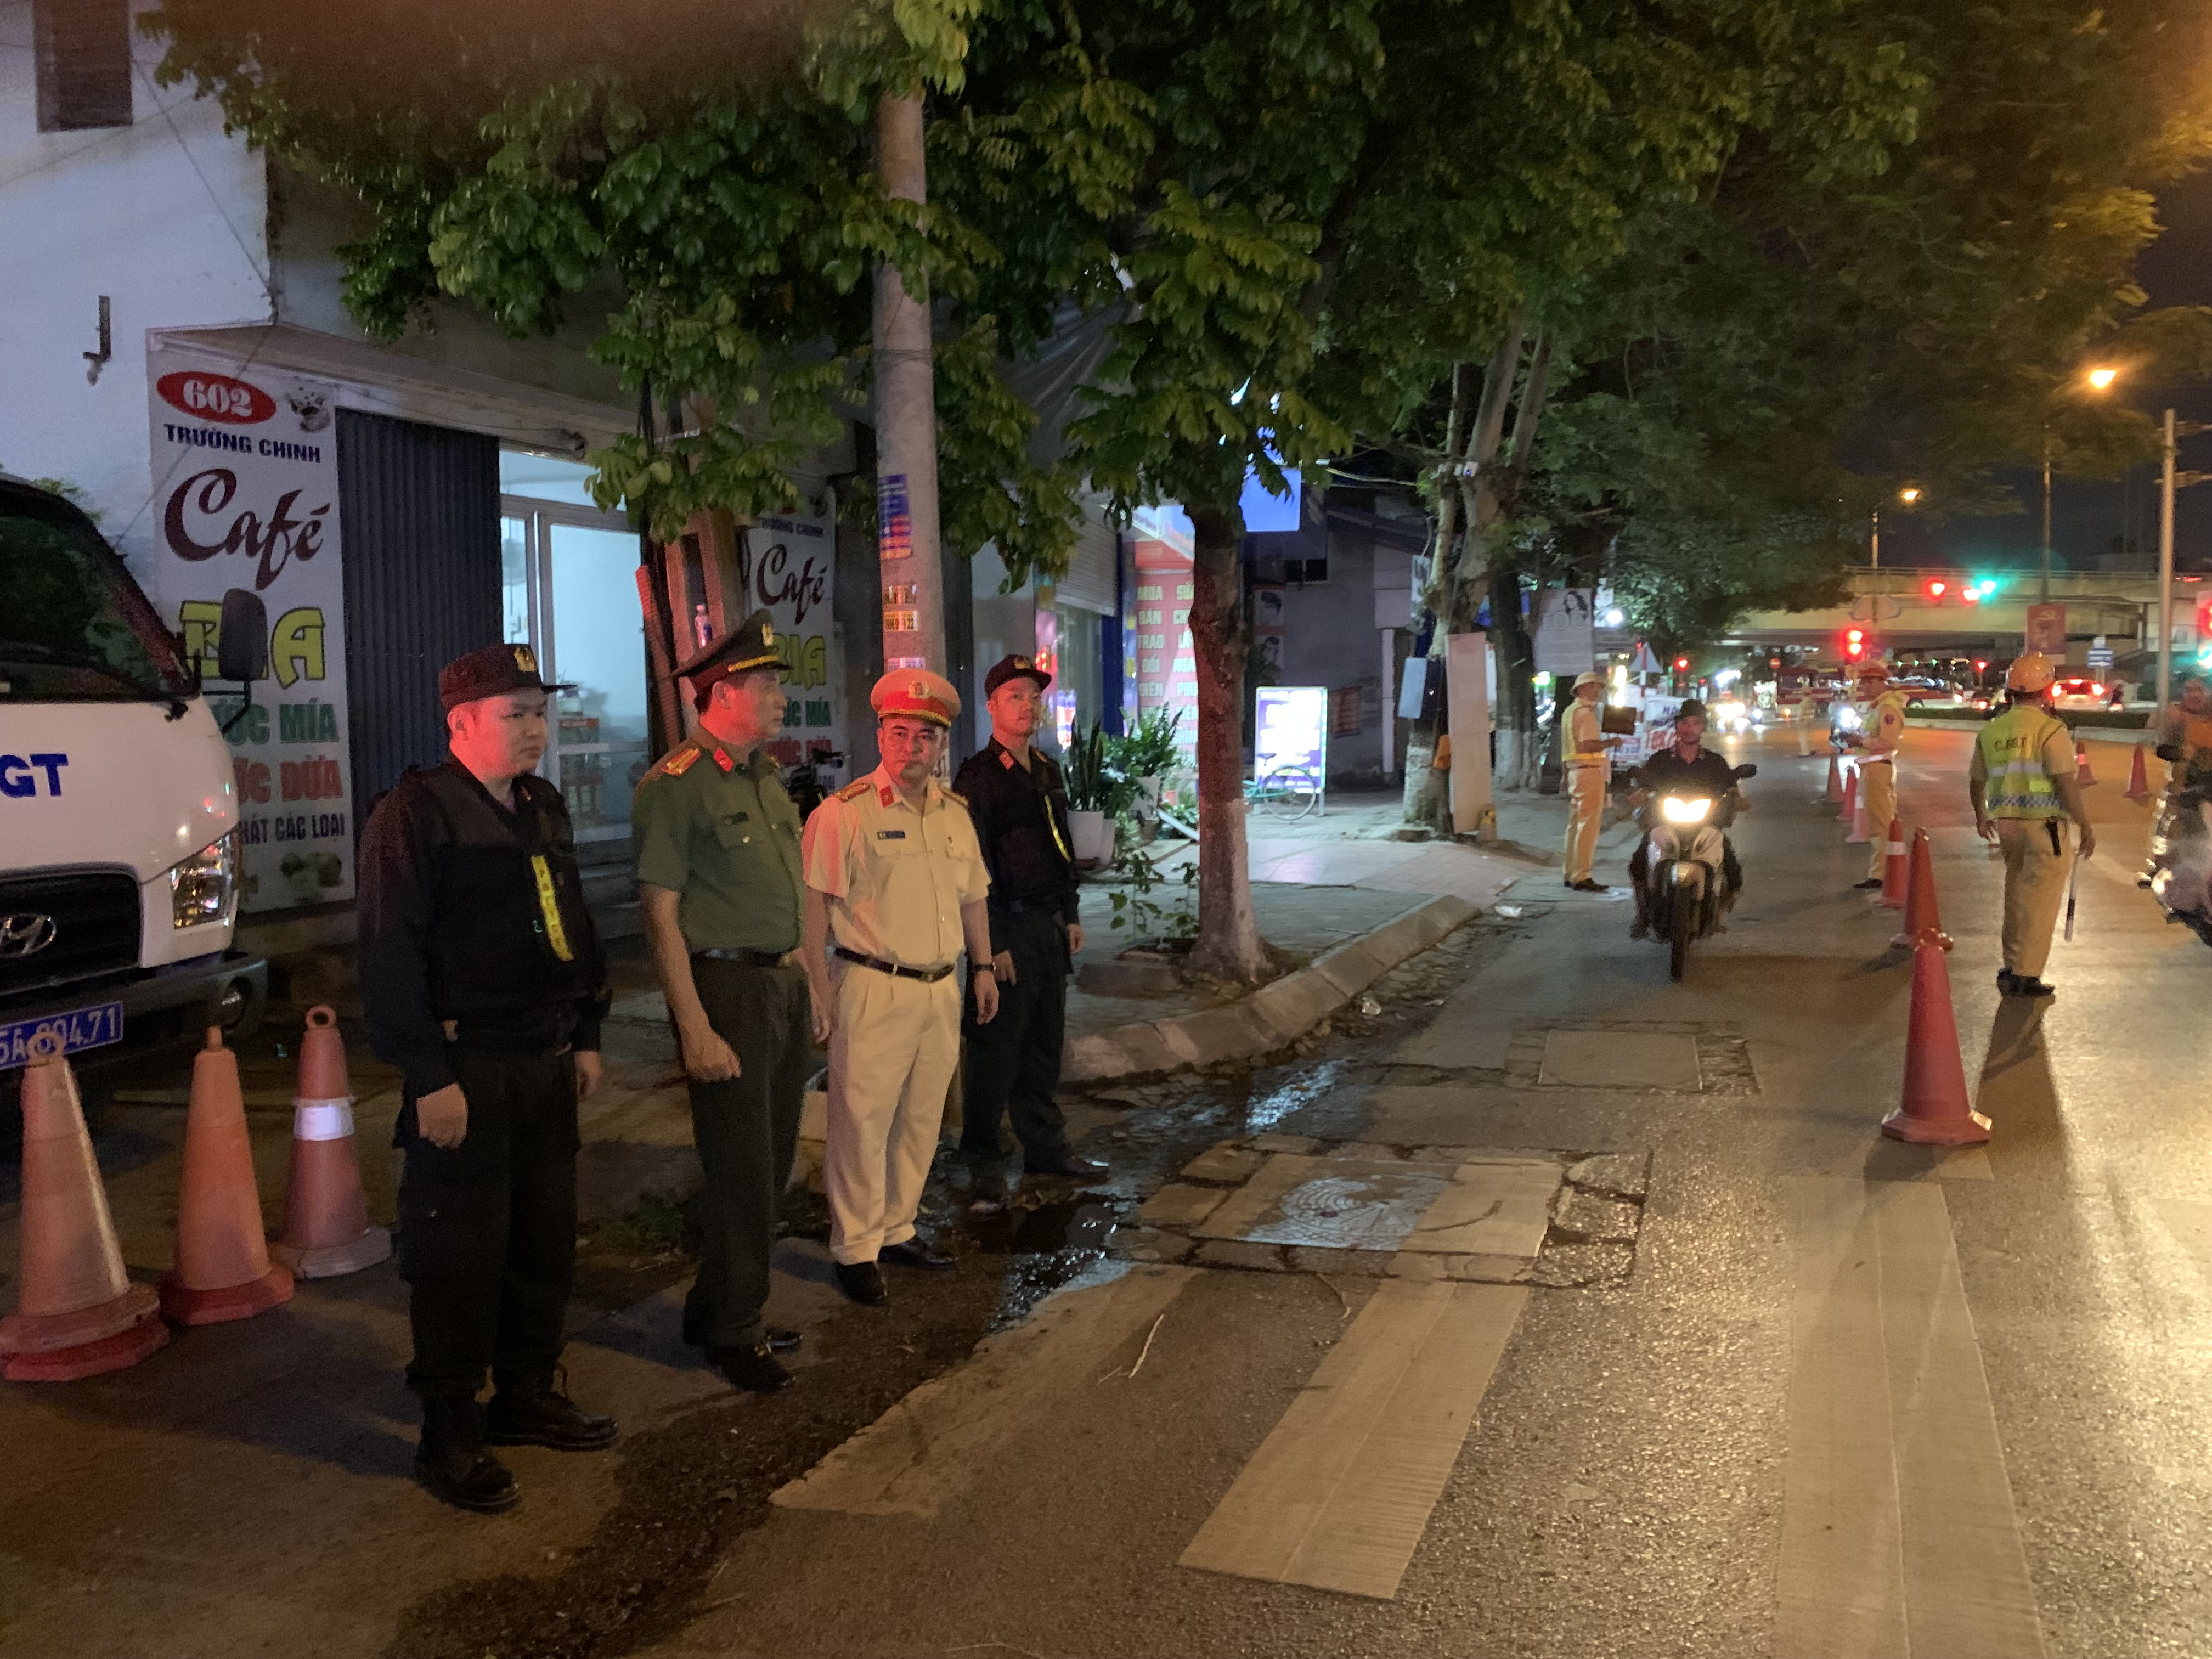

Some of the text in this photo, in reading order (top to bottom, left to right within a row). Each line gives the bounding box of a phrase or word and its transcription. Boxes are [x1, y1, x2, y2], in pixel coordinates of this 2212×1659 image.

[183, 379, 253, 417] 602
[259, 438, 321, 463] CHINH
[165, 468, 330, 591] Café
[757, 544, 828, 625] Café
[179, 600, 325, 690] BA
[1173, 657, 1196, 673] NGA
[0, 753, 69, 798] GT
